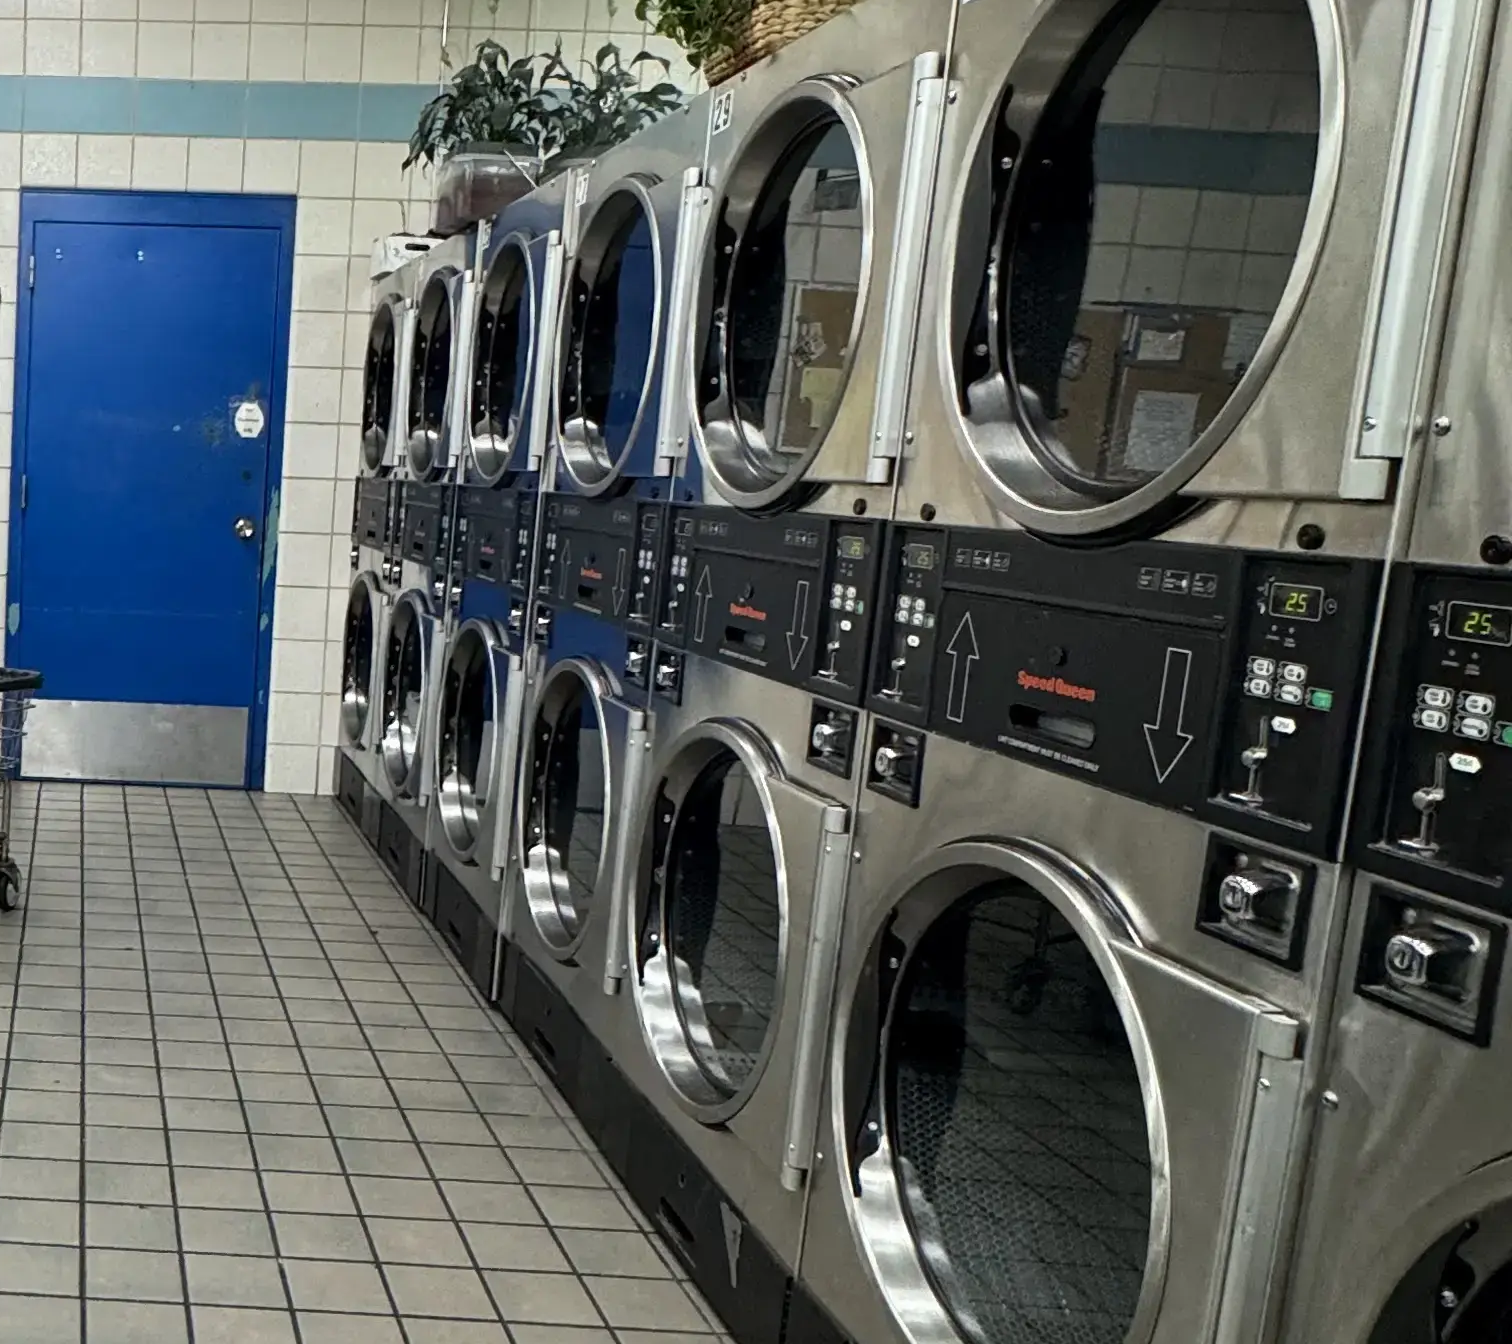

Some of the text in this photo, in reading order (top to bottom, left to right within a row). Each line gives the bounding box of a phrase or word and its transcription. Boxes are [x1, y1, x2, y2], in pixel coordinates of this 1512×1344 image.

[714, 93, 732, 131] 29
[1284, 592, 1309, 613] 25
[1463, 611, 1493, 636] 25
[1017, 670, 1096, 702] Speed Queen
